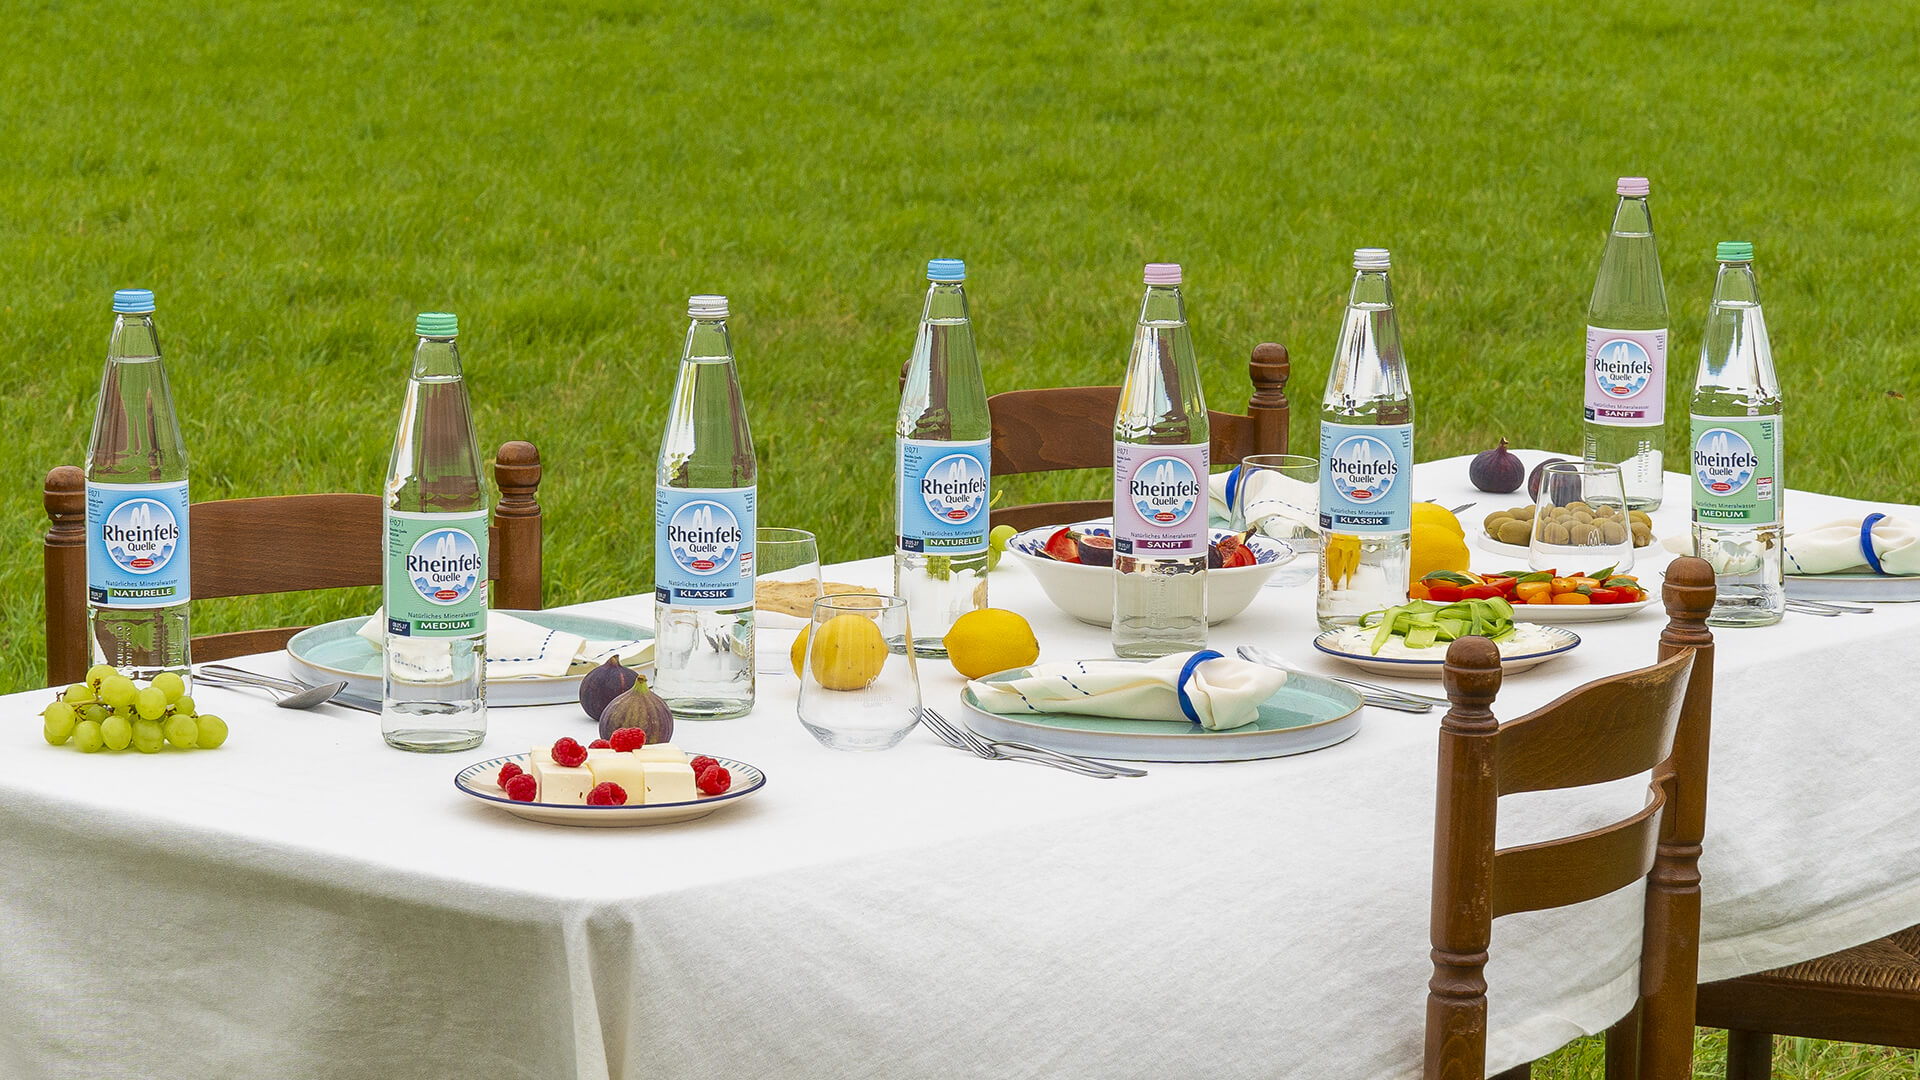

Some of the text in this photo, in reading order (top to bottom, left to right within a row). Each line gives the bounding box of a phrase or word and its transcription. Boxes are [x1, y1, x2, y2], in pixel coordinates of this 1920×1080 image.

[1594, 358, 1653, 374] Rheinfels
[1694, 451, 1758, 467] Rheinfels
[1330, 458, 1398, 475] Rheinfels
[1709, 467, 1733, 476] Quelle
[1349, 474, 1375, 483] Quelle
[921, 477, 986, 495] Rheinfels
[1129, 480, 1200, 497] Rheinfels
[945, 494, 970, 504] Quelle
[1152, 497, 1179, 506] Quelle
[1702, 509, 1744, 518] MEDIUM
[1340, 516, 1383, 525] KLASSIK
[103, 523, 179, 542] Rheinfels
[667, 525, 742, 543] Rheinfels
[930, 537, 980, 546] NATURELLE
[127, 542, 157, 552] Quelle
[689, 543, 718, 553] Quelle
[406, 553, 482, 573] Rheinfels
[432, 572, 461, 582] Quelle
[105, 580, 137, 588] Natürliches
[668, 580, 740, 588] Natürliches Mineralwasser
[113, 588, 172, 597] NATURELLE
[680, 590, 727, 598] KLASSIK
[407, 611, 441, 619] Natürliches
[420, 620, 471, 630] MEDIUM
